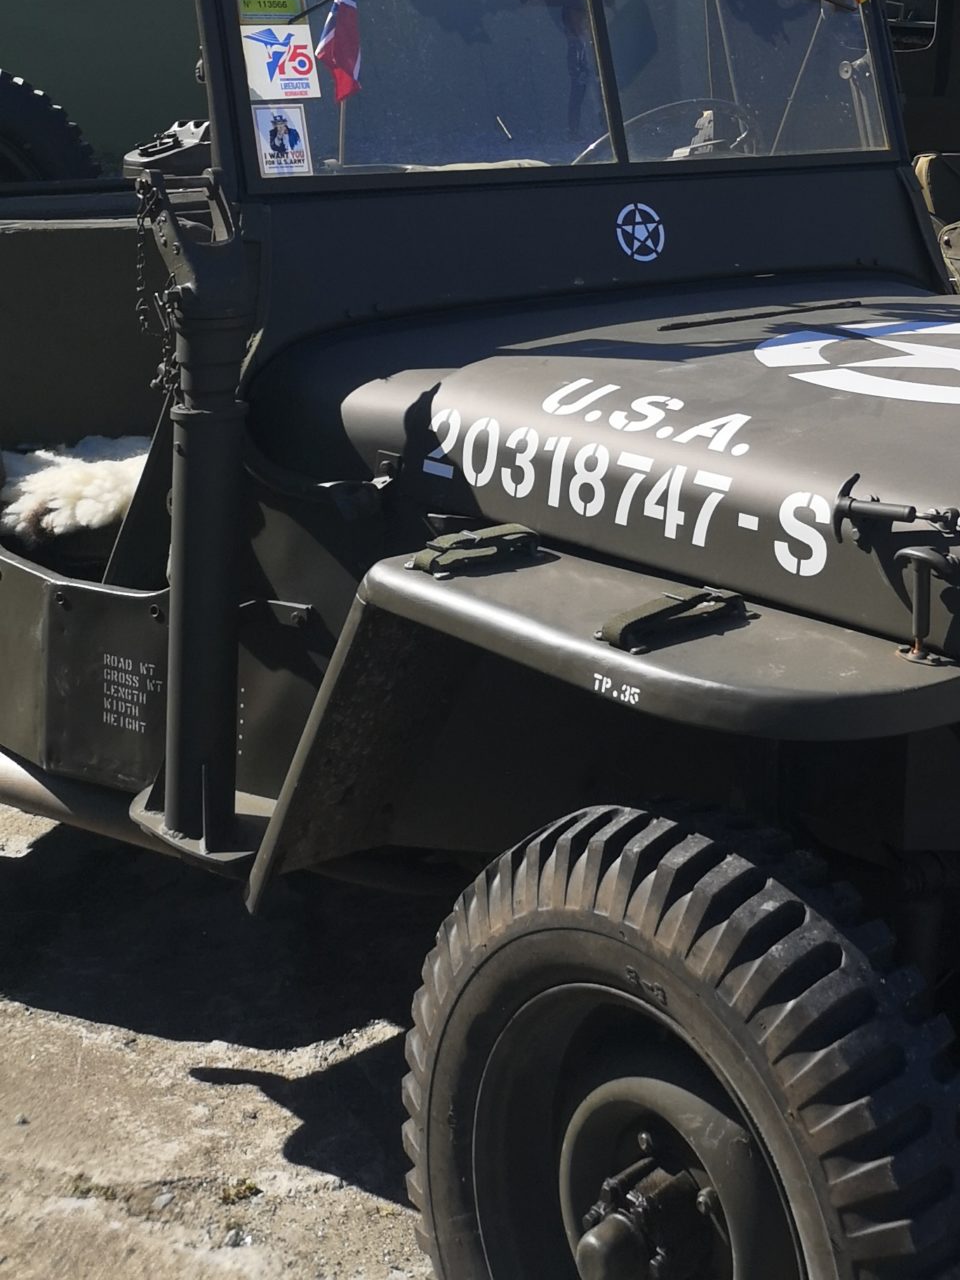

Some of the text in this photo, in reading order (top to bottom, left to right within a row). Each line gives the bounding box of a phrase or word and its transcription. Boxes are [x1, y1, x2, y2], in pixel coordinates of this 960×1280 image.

[542, 377, 751, 457] U.S.A.
[422, 408, 831, 577] 20318747-S
[104, 653, 133, 671] ROAD
[104, 668, 140, 688] GROSS
[104, 682, 147, 705] LENGTH
[103, 711, 147, 734] HEIGHT
